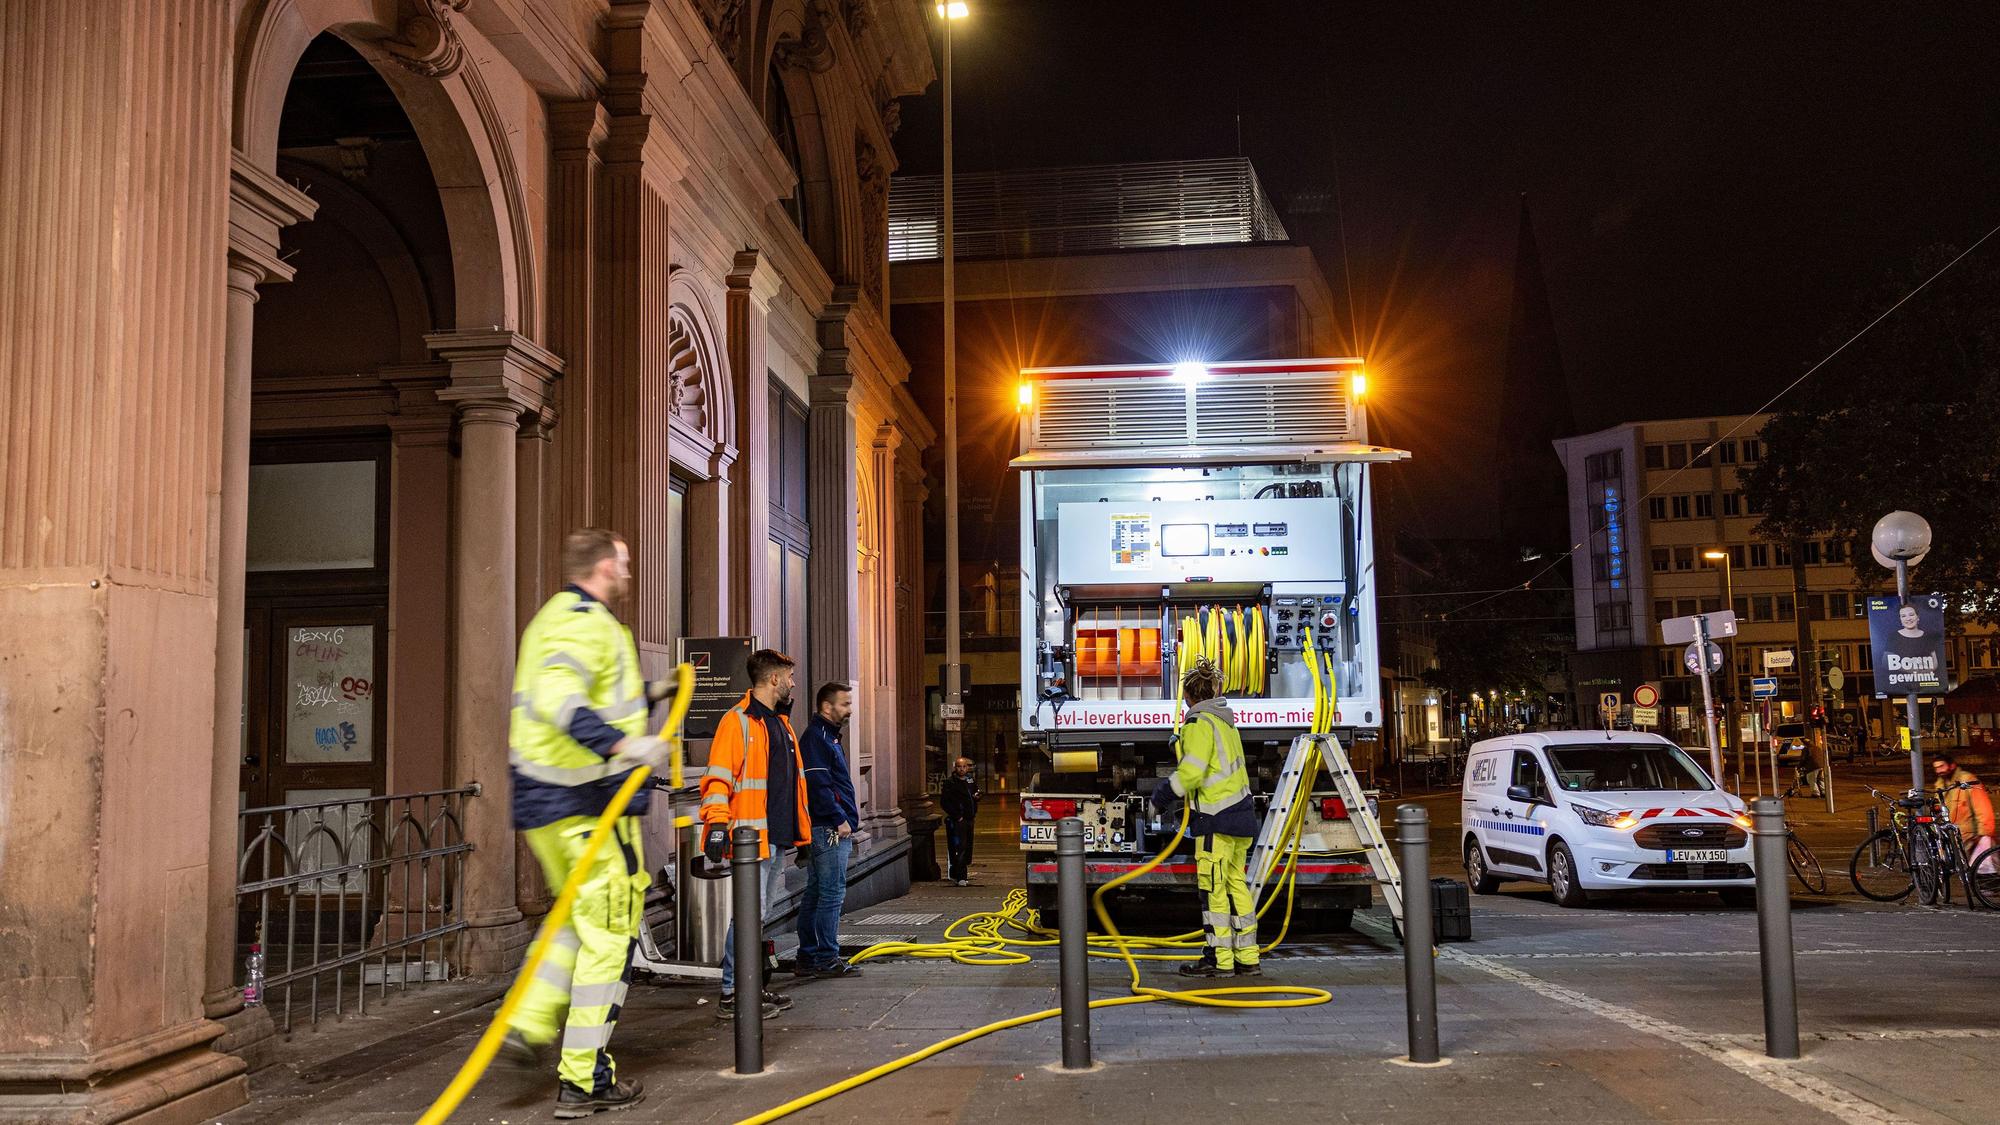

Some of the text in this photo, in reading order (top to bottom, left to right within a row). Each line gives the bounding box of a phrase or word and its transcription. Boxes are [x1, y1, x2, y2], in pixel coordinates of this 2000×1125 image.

[1887, 654, 1934, 671] Bonn
[1889, 671, 1939, 685] gewinnt.
[1028, 827, 1053, 840] LEV
[1673, 850, 1725, 861] LEV XX 150
